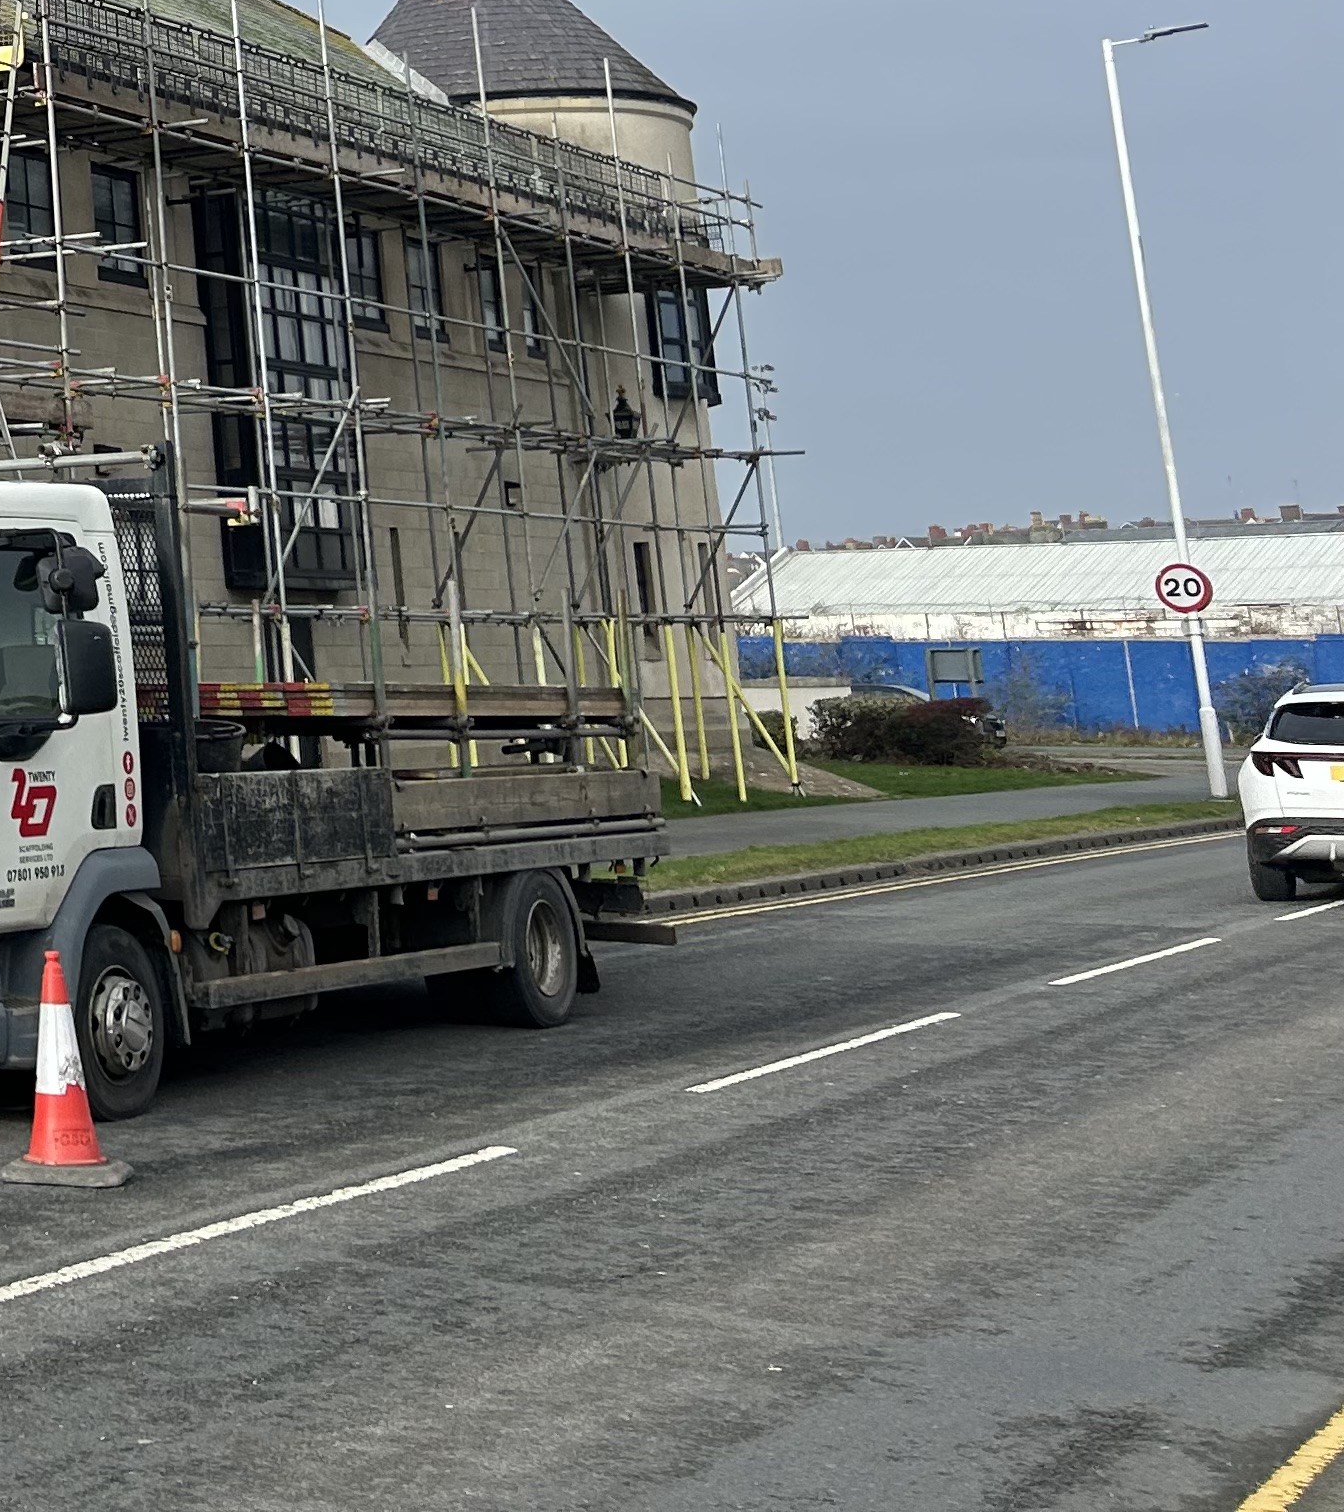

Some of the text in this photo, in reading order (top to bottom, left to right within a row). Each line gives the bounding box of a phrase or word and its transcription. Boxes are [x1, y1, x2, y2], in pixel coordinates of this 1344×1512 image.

[1164, 578, 1201, 597] 20
[27, 770, 56, 783] TWENTY
[7, 864, 65, 883] 07801 950 913
